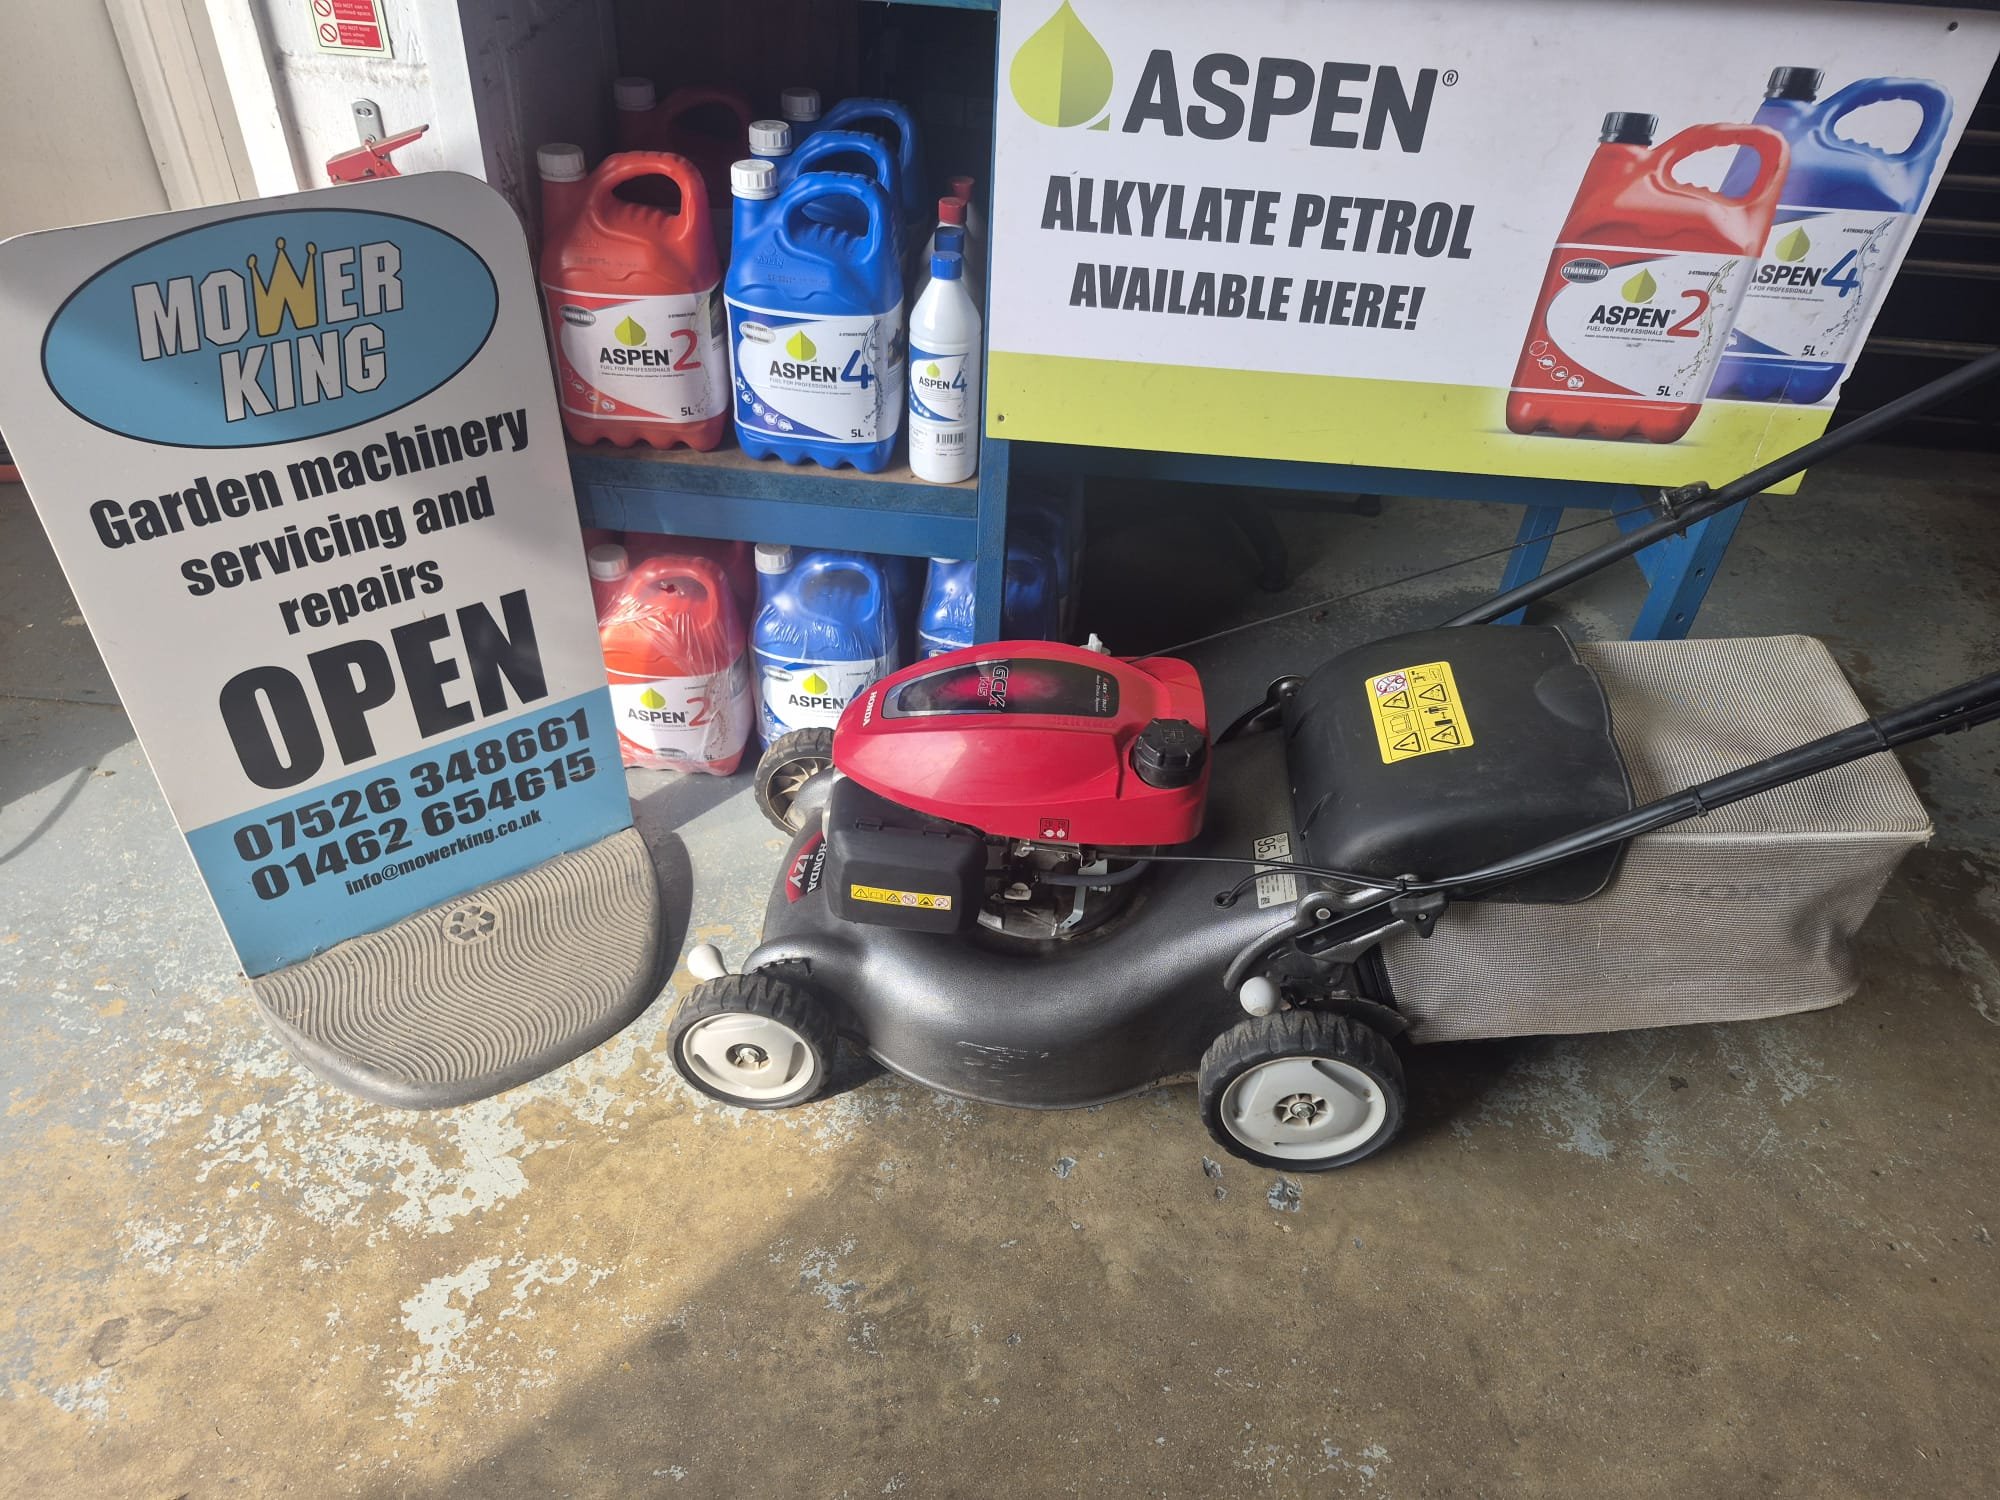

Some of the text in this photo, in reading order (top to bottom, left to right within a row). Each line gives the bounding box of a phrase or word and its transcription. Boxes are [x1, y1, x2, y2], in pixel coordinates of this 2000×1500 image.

[1041, 175, 1475, 260] ALKYLATE PETROL
[1069, 262, 1426, 331] AVAILABLE HERE!
[1766, 286, 1813, 295] PROFESSIONALS
[1821, 249, 1859, 298] 4
[132, 238, 404, 361] MOWER
[1666, 289, 1710, 337] 2
[600, 328, 703, 372] ASPEN 2
[1615, 328, 1663, 336] PROFESSIONALS
[1801, 345, 1816, 356] 5L
[219, 324, 387, 423] KING
[769, 349, 874, 390] ASPEN 4
[919, 370, 968, 393] ASPEN 4
[1656, 386, 1671, 397] 5L
[680, 406, 694, 416] 5L
[851, 429, 864, 438] 5L
[89, 408, 530, 549] Garden machinery
[181, 476, 495, 596] servicing and
[279, 560, 444, 635] repairs
[219, 588, 549, 789] OPEN
[628, 696, 711, 727] ASPEN 2
[788, 694, 844, 710] ASPEN
[862, 691, 877, 728] HONDA
[233, 707, 592, 862] 07526 348661
[251, 750, 596, 901] 01462 654615
[1257, 837, 1277, 854] 95
[345, 809, 543, 897] info@mowerking.co.uk
[789, 854, 814, 889] izy
[807, 843, 827, 893] HONDA
